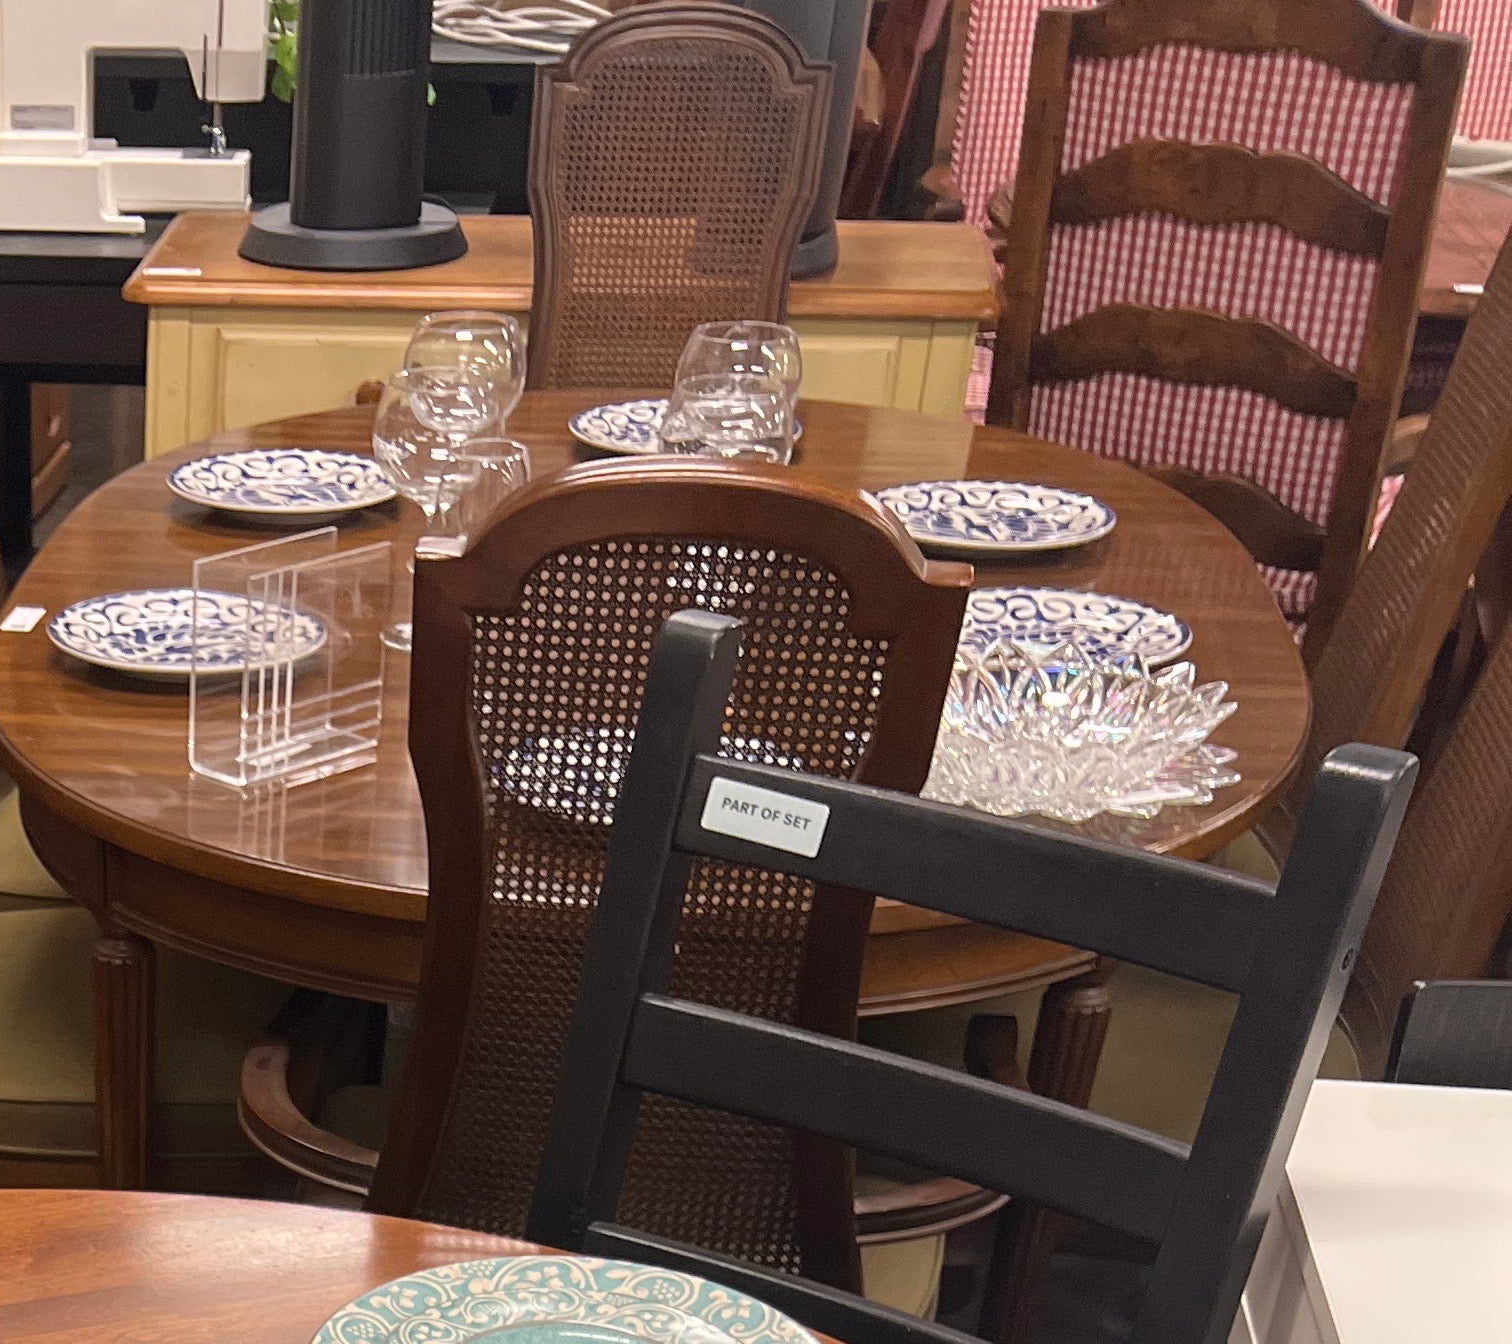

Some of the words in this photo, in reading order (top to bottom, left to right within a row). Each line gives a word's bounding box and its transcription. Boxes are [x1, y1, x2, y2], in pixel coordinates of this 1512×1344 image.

[721, 797, 759, 817] PART
[761, 807, 782, 822] OF
[783, 813, 812, 831] SET
